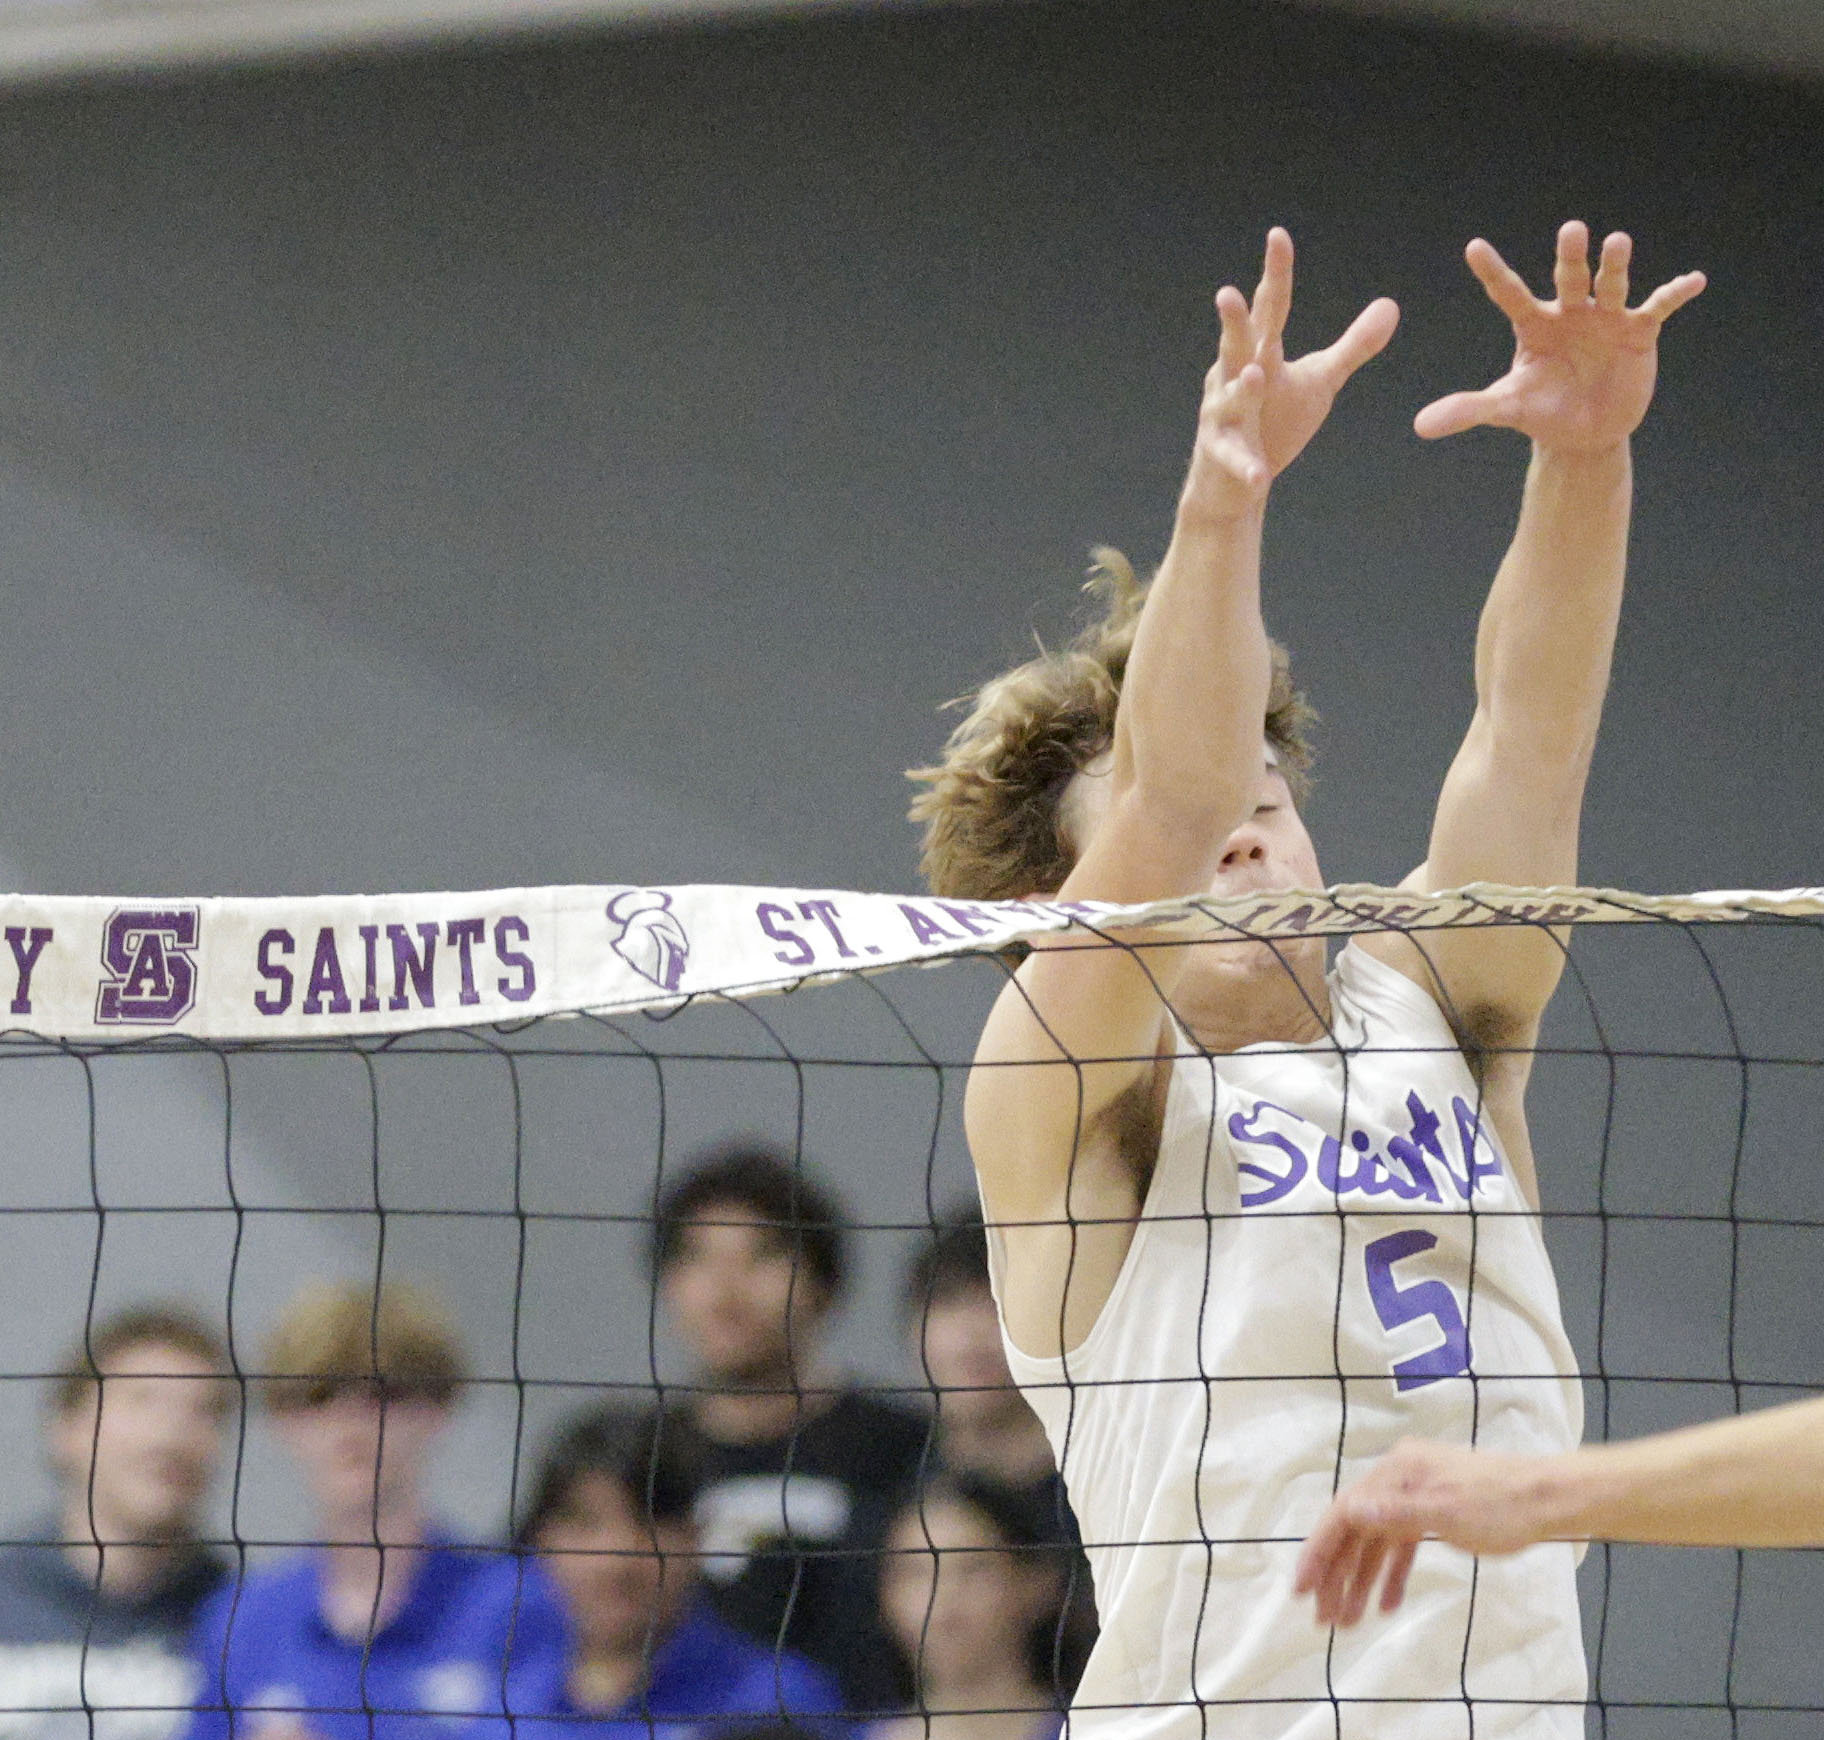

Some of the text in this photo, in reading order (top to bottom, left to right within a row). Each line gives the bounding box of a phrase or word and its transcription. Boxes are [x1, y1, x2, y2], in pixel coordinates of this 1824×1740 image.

[253, 912, 538, 1016] SAINTS
[756, 899, 883, 967] ST.
[1363, 1228, 1474, 1393] 5
